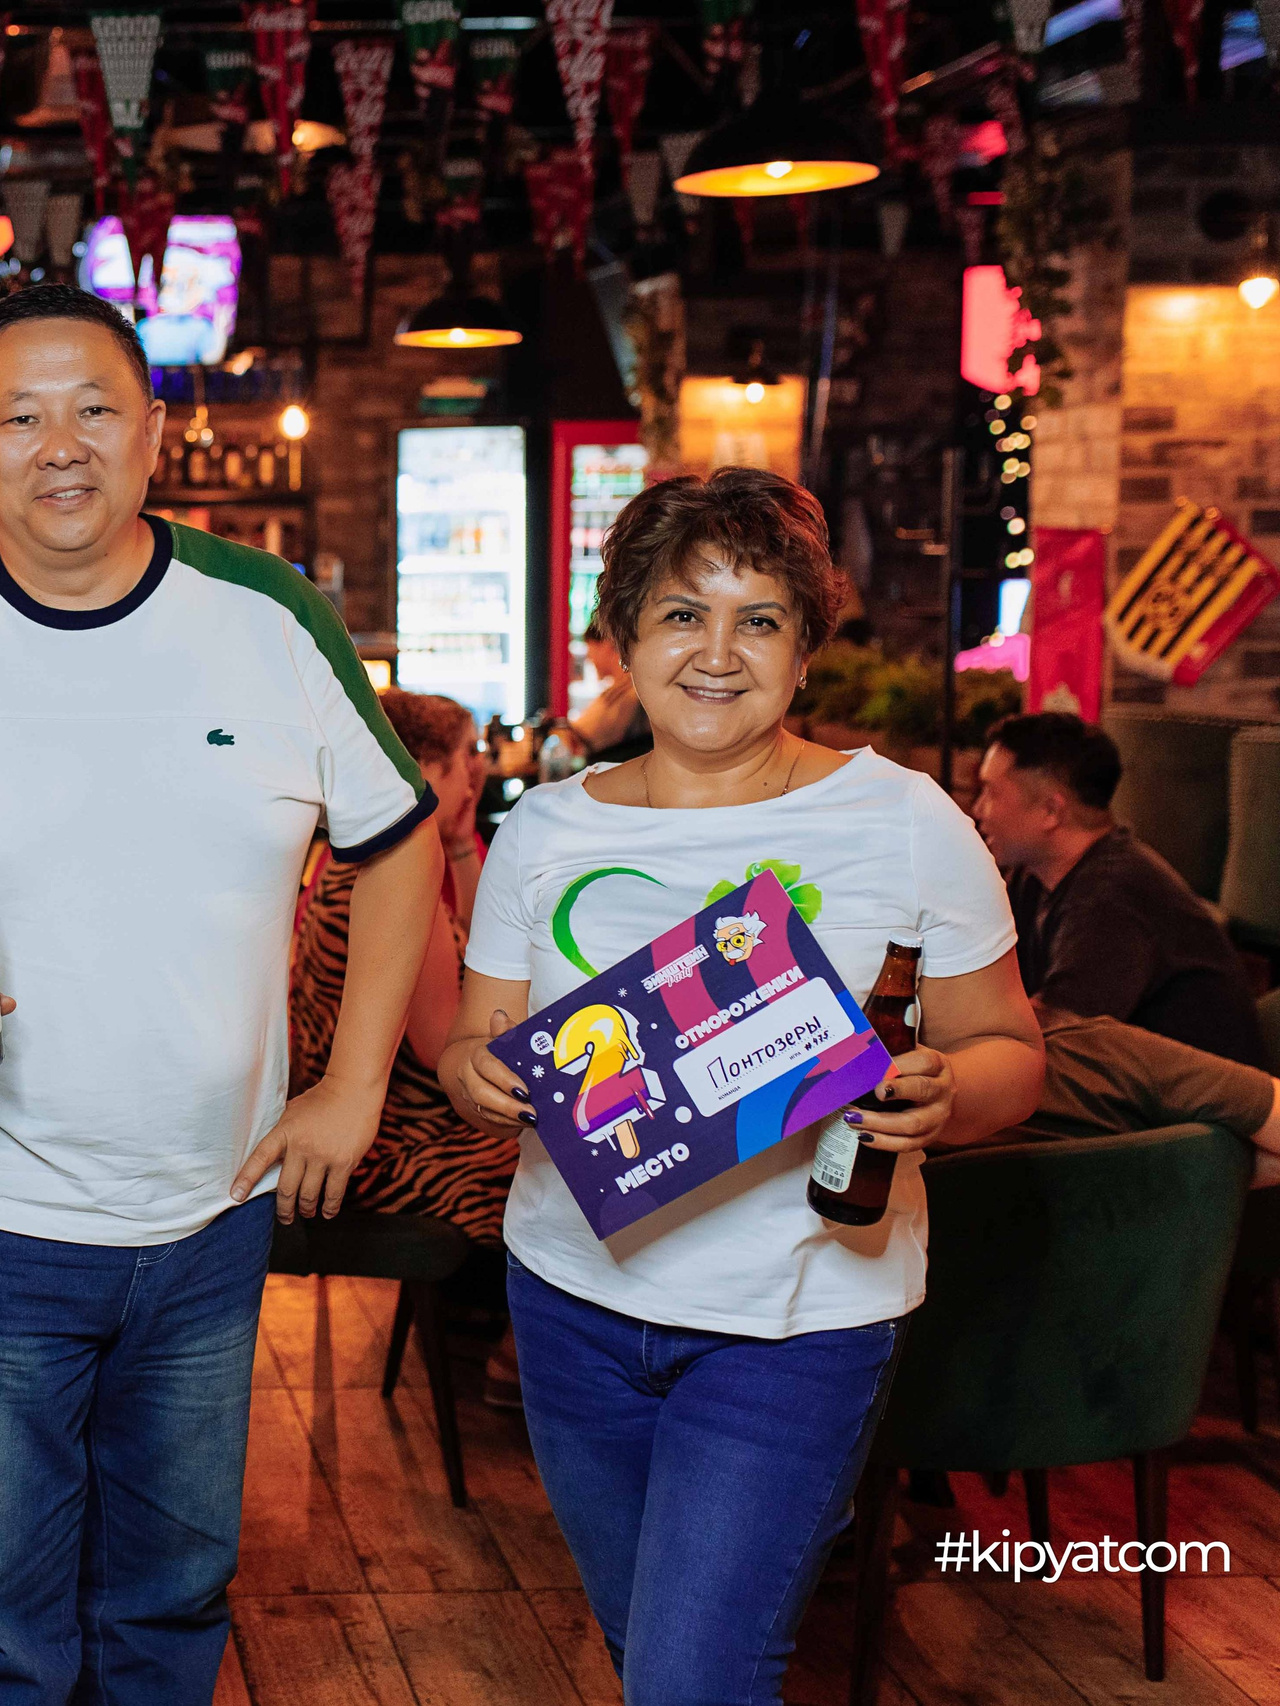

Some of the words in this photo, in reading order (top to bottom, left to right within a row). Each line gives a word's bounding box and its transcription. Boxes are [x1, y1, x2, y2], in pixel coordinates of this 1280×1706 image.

[642, 944, 710, 992] ЭЙНШТЕЙН
[675, 965, 805, 1049] ОТМОРОЖЕНКИ
[707, 1016, 821, 1088] Понтозеры
[718, 1085, 741, 1100] КОМАНДА
[614, 1143, 690, 1195] МЕСТО
